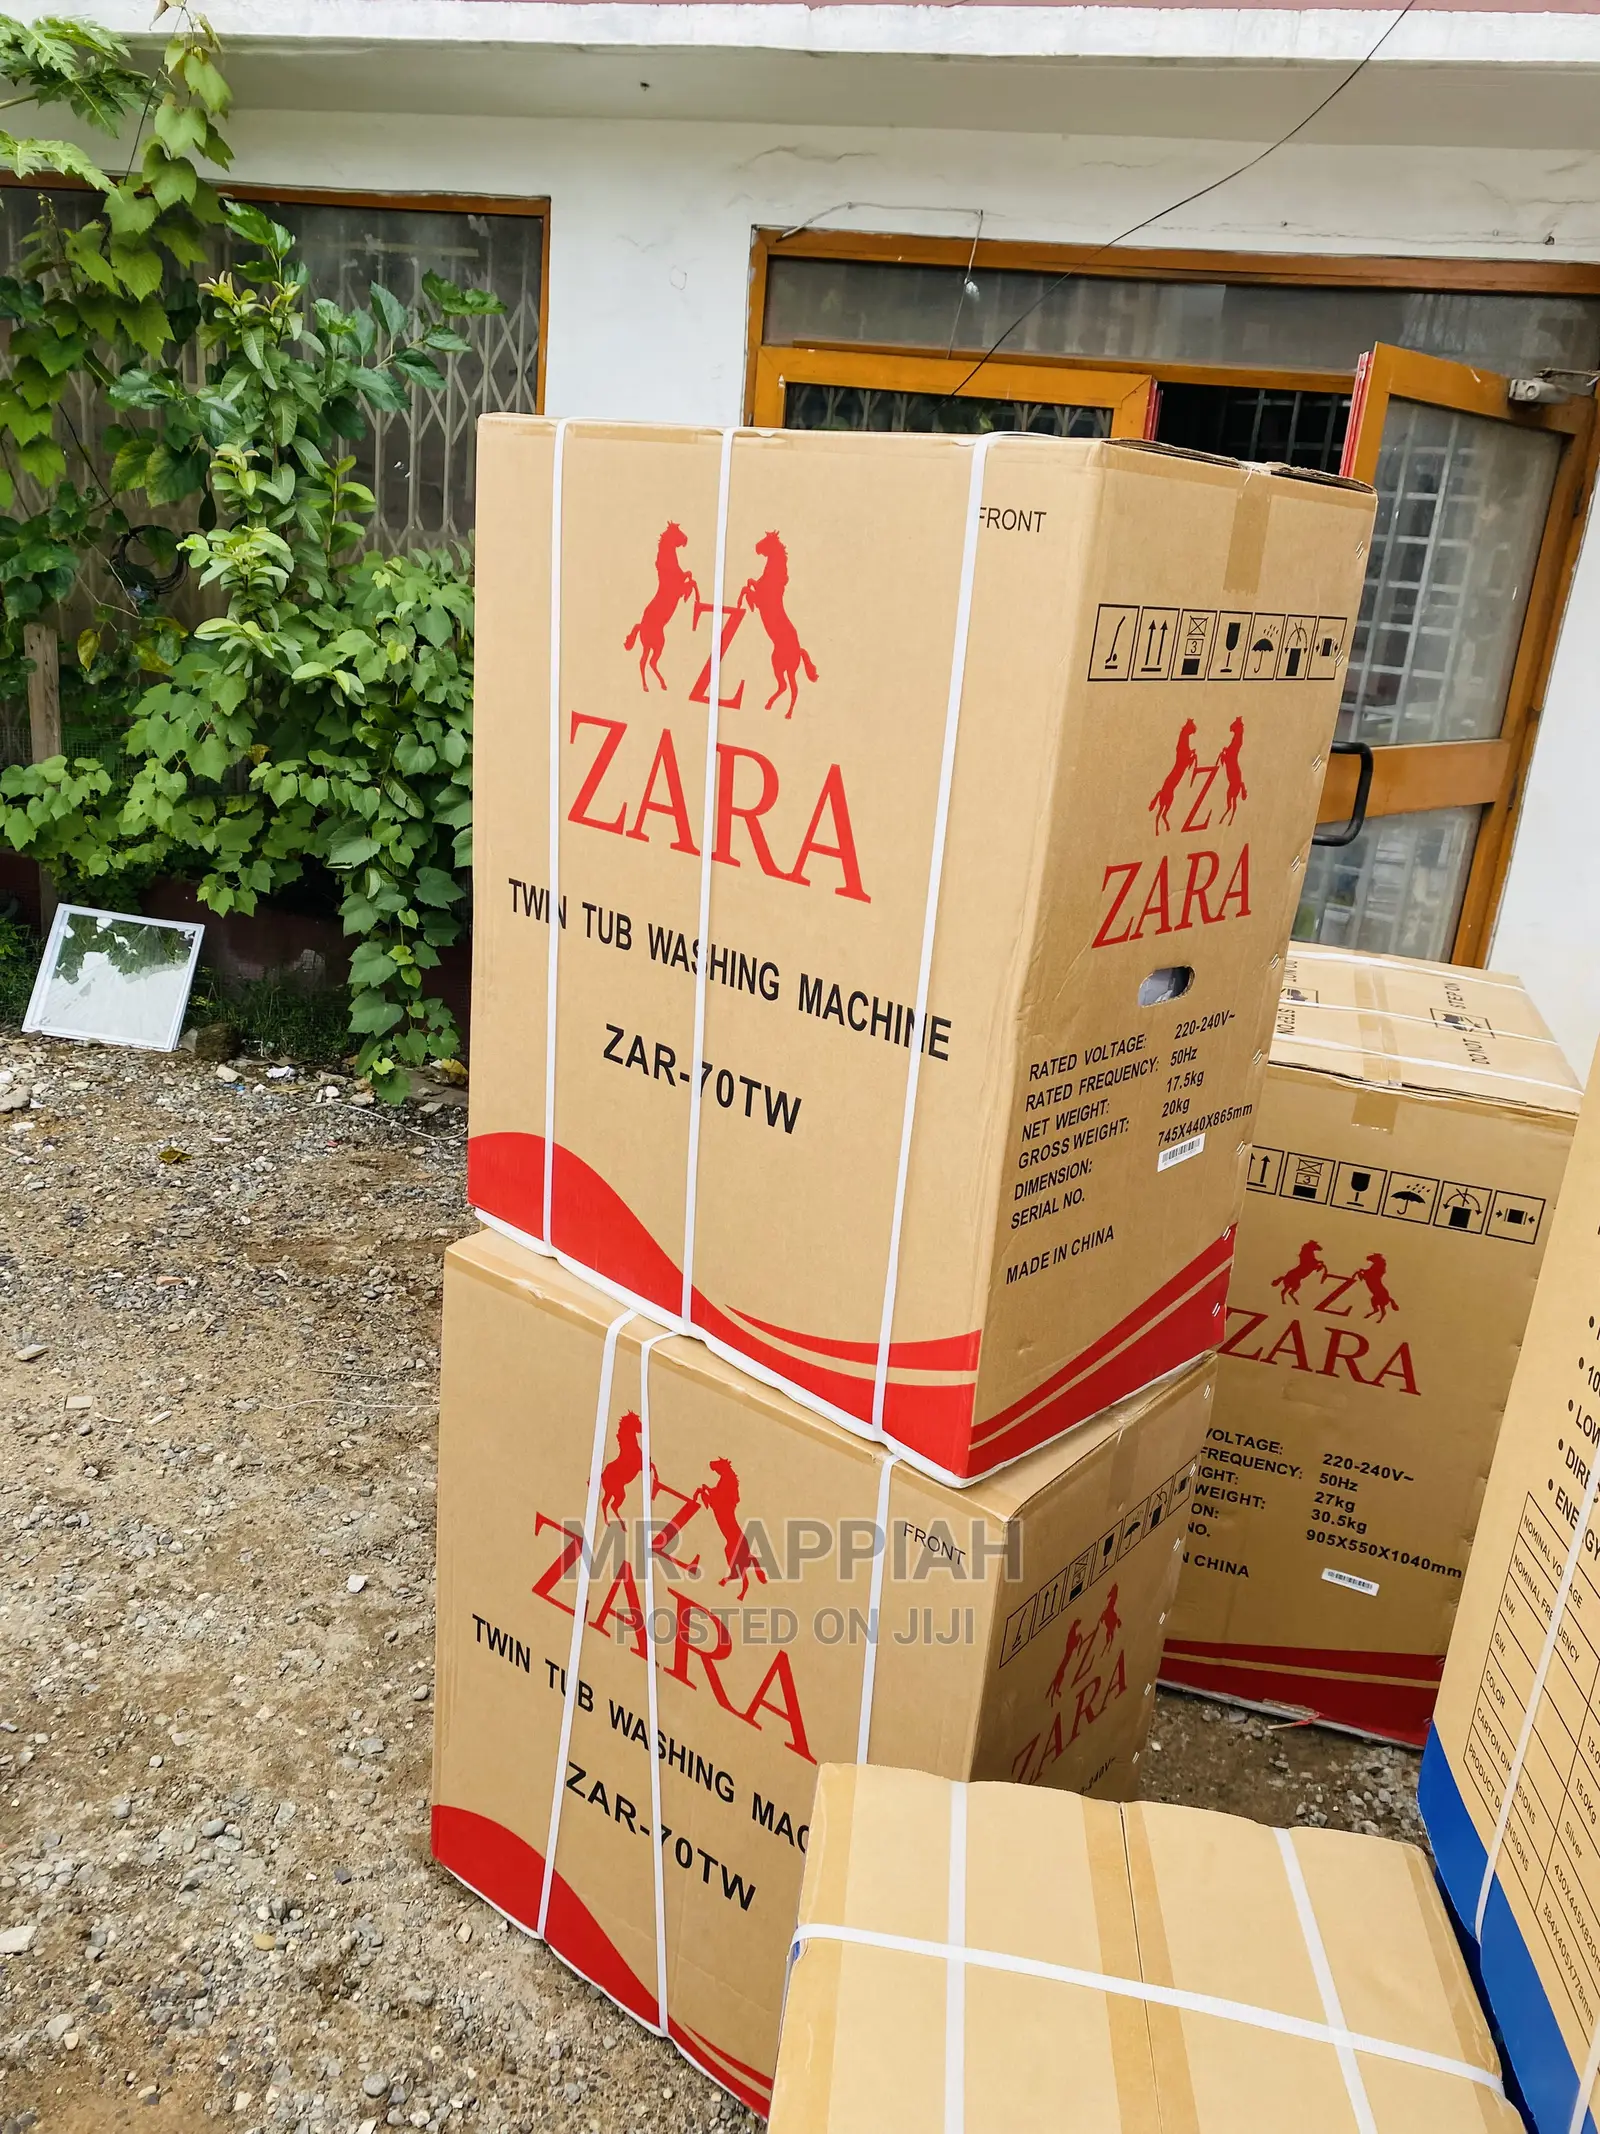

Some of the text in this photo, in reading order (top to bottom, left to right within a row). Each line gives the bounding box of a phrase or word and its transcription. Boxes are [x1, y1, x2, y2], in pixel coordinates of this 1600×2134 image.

[567, 709, 873, 905] ZARA
[1091, 842, 1252, 949] ZARA
[508, 878, 953, 1062] TWIN TUB WASHING MACHINE
[603, 1023, 802, 1135] ZAR-70TW
[1025, 1045, 1198, 1112] RATED FREQUENCY: 50Hz
[1029, 1053, 1077, 1082] RATED
[1084, 1033, 1147, 1066] VOLTAGE:
[1018, 1097, 1191, 1169] GROSS WEIGHT: 20kg
[1021, 1069, 1205, 1142] NET WEIGHT: 17.5kg
[1014, 1103, 1253, 1201] DIMENSION: 745X440X865mm
[1010, 1188, 1086, 1230] SERIAL NO.
[1005, 1225, 1115, 1285] MADE IN CHINA
[1216, 1306, 1422, 1396] ZARA
[1195, 1483, 1368, 1534] WEIGHT: 30.5kg
[1198, 1465, 1356, 1513] IGHT: 27kg
[1319, 1472, 1359, 1492] 50Hz
[903, 1522, 966, 1567] FRONT
[1306, 1528, 1462, 1579] 905X550X1040mm
[1555, 1486, 1600, 1561] ENEGY
[1194, 1555, 1249, 1578] CHINA
[1523, 1514, 1583, 1609] NOMINAL VOAGE
[532, 1511, 818, 1766] ZARA
[1513, 1553, 1580, 1664] NOMINAL FREUENCY
[472, 1613, 531, 1673] TWIN
[608, 1699, 735, 1804] WASHING
[1011, 1649, 1128, 1785] ZARA
[1485, 1669, 1506, 1709] COLOR
[1477, 1707, 1537, 1825] CARTON DIMSIONS
[1587, 1735, 1600, 1770] 13.0
[566, 1761, 757, 1912] ZAR-70TW
[1468, 1742, 1530, 1872] PRODUCT DIENSIONS
[1564, 1821, 1583, 1860] Silver
[1554, 1864, 1600, 1973] 430X445X820m
